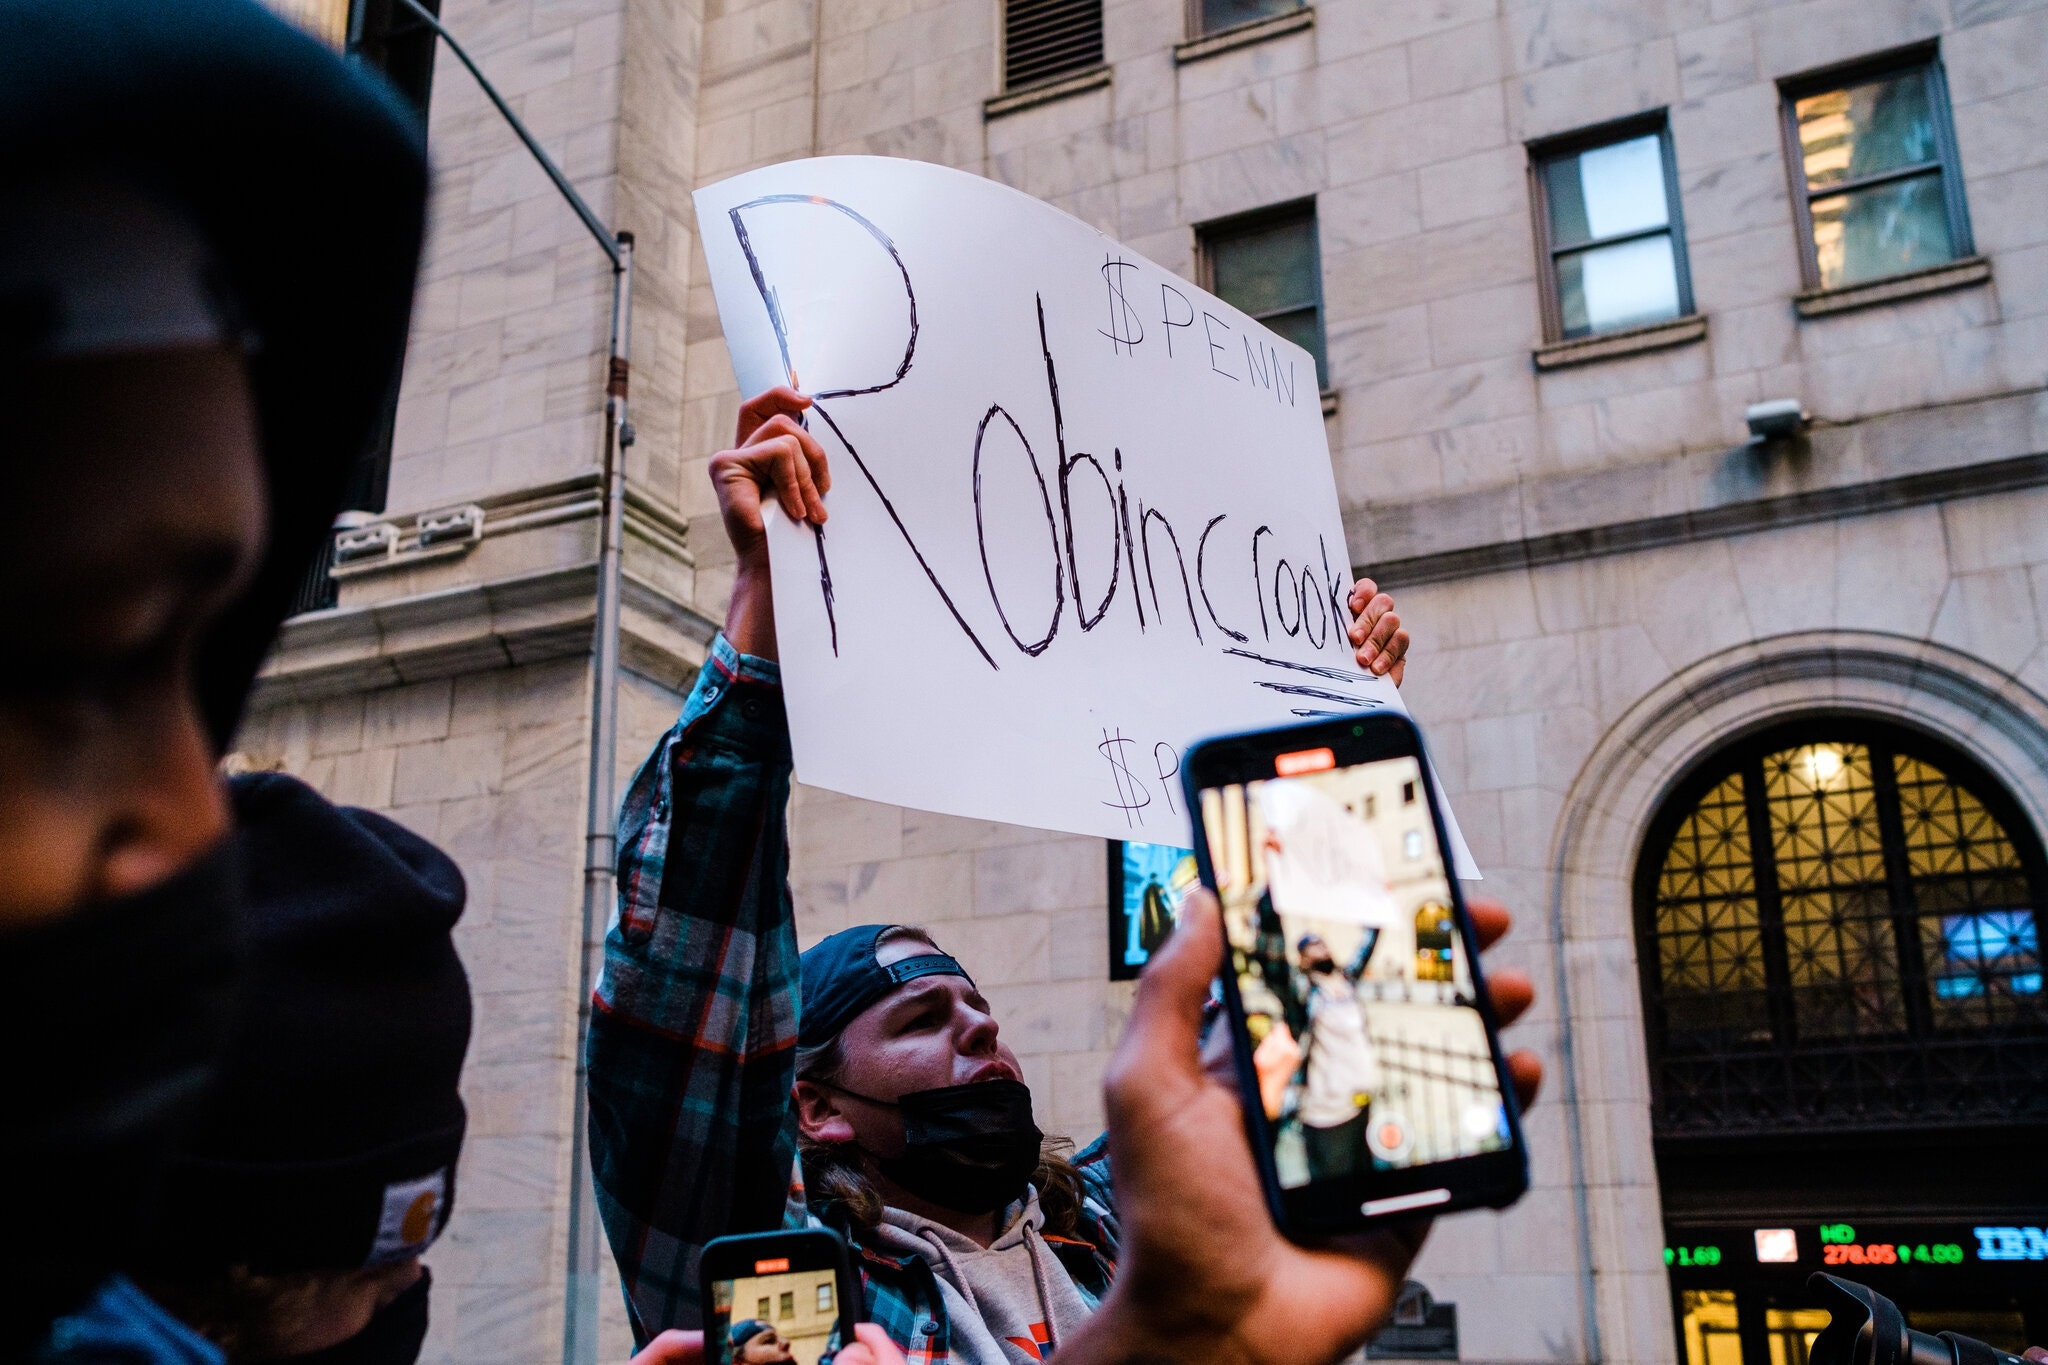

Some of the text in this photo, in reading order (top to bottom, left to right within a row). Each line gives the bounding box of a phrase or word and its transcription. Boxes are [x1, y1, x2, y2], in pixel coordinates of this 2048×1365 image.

[1097, 252, 1295, 408] $PENN
[1097, 726, 1190, 829] $P
[1820, 1223, 1855, 1244] HD
